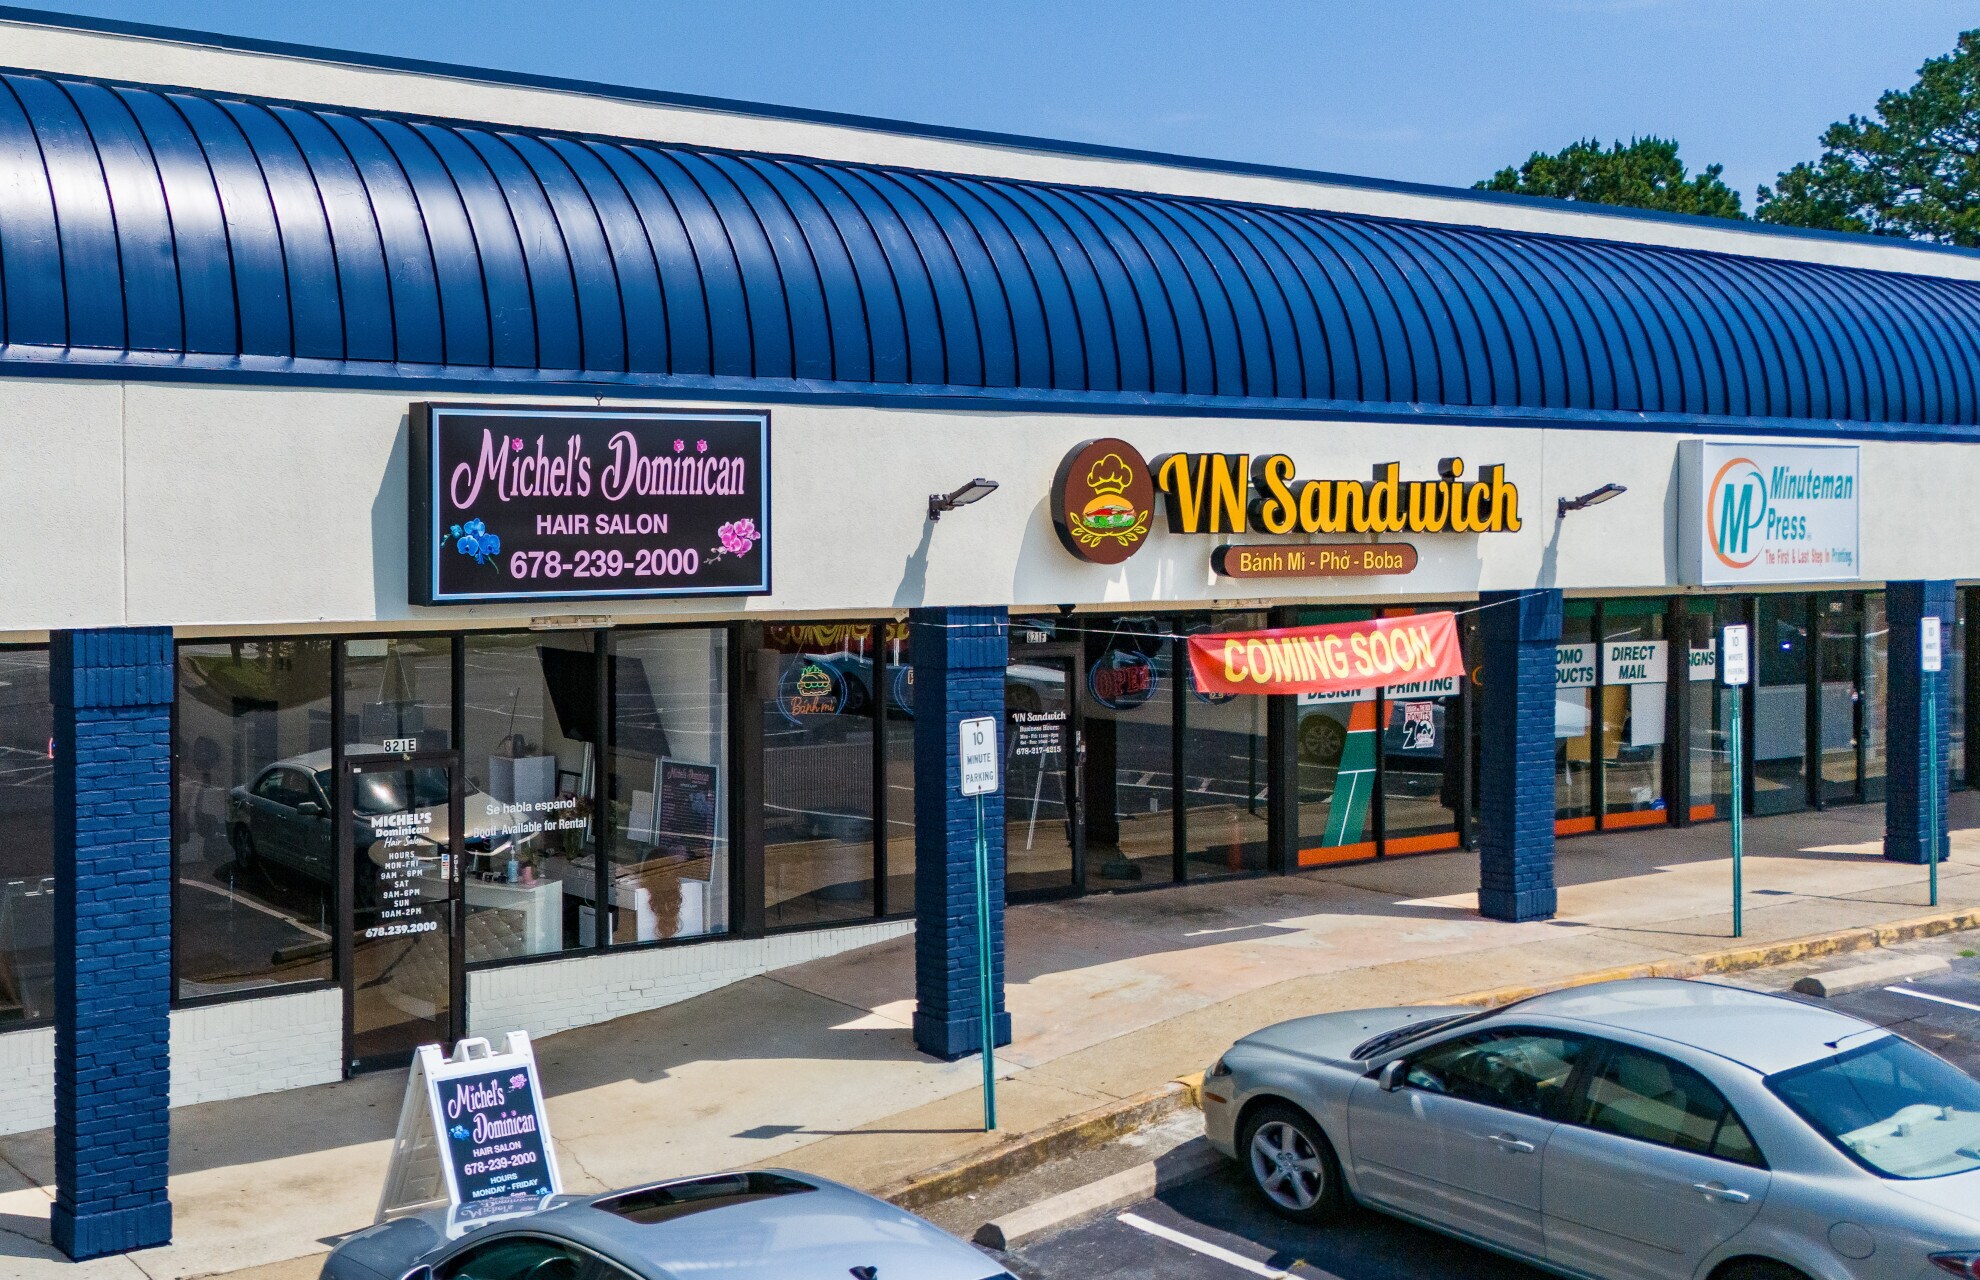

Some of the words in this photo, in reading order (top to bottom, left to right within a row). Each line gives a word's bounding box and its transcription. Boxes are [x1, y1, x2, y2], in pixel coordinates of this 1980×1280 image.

[451, 428, 591, 510] Michel's
[601, 430, 745, 501] Dominican
[1770, 465, 1853, 500] Minuteman
[1157, 452, 1251, 534] VN
[1260, 453, 1522, 534] Sandwich
[536, 514, 589, 535] HAIR
[595, 513, 669, 535] SALON
[1766, 507, 1807, 541] Press
[510, 548, 699, 580] 678-239-2000
[1239, 552, 1283, 572] Bánh
[1363, 550, 1403, 570] Boba
[1224, 633, 1350, 684] COMING
[1350, 625, 1436, 678] SOON
[1611, 645, 1655, 662] DIRECT
[1618, 664, 1647, 680] MAIL
[1012, 712, 1026, 723] VN
[1027, 711, 1067, 722] Sandwich
[384, 739, 416, 752] 821E
[972, 731, 984, 746] 10
[966, 752, 992, 765] MINUTE
[965, 771, 994, 784] PARKING
[486, 804, 500, 815] Se
[503, 801, 532, 814] habla
[534, 797, 576, 812] espanol
[370, 812, 432, 829] MICHEL'S
[501, 821, 542, 835] Available
[544, 819, 557, 831] for
[558, 816, 587, 830] Rental
[375, 825, 430, 838] Dominican
[383, 837, 402, 848] Hair
[388, 850, 415, 860] HOURS
[384, 860, 419, 869] MON-FRI
[380, 871, 397, 880] 9AM
[394, 880, 409, 888] SAT
[393, 899, 410, 907] SUN
[381, 907, 422, 918] 10AM-2PM
[365, 921, 437, 938] 678.239.2000
[448, 1078, 505, 1119] Michel's
[472, 1112, 537, 1144] Dominican
[472, 1145, 494, 1158] HAIR
[494, 1141, 522, 1154] SALON
[464, 1151, 537, 1176] 678-239-2000
[490, 1173, 518, 1184] HOURS
[472, 1185, 506, 1198] MONDAY
[511, 1178, 538, 1190] FRIDAY
